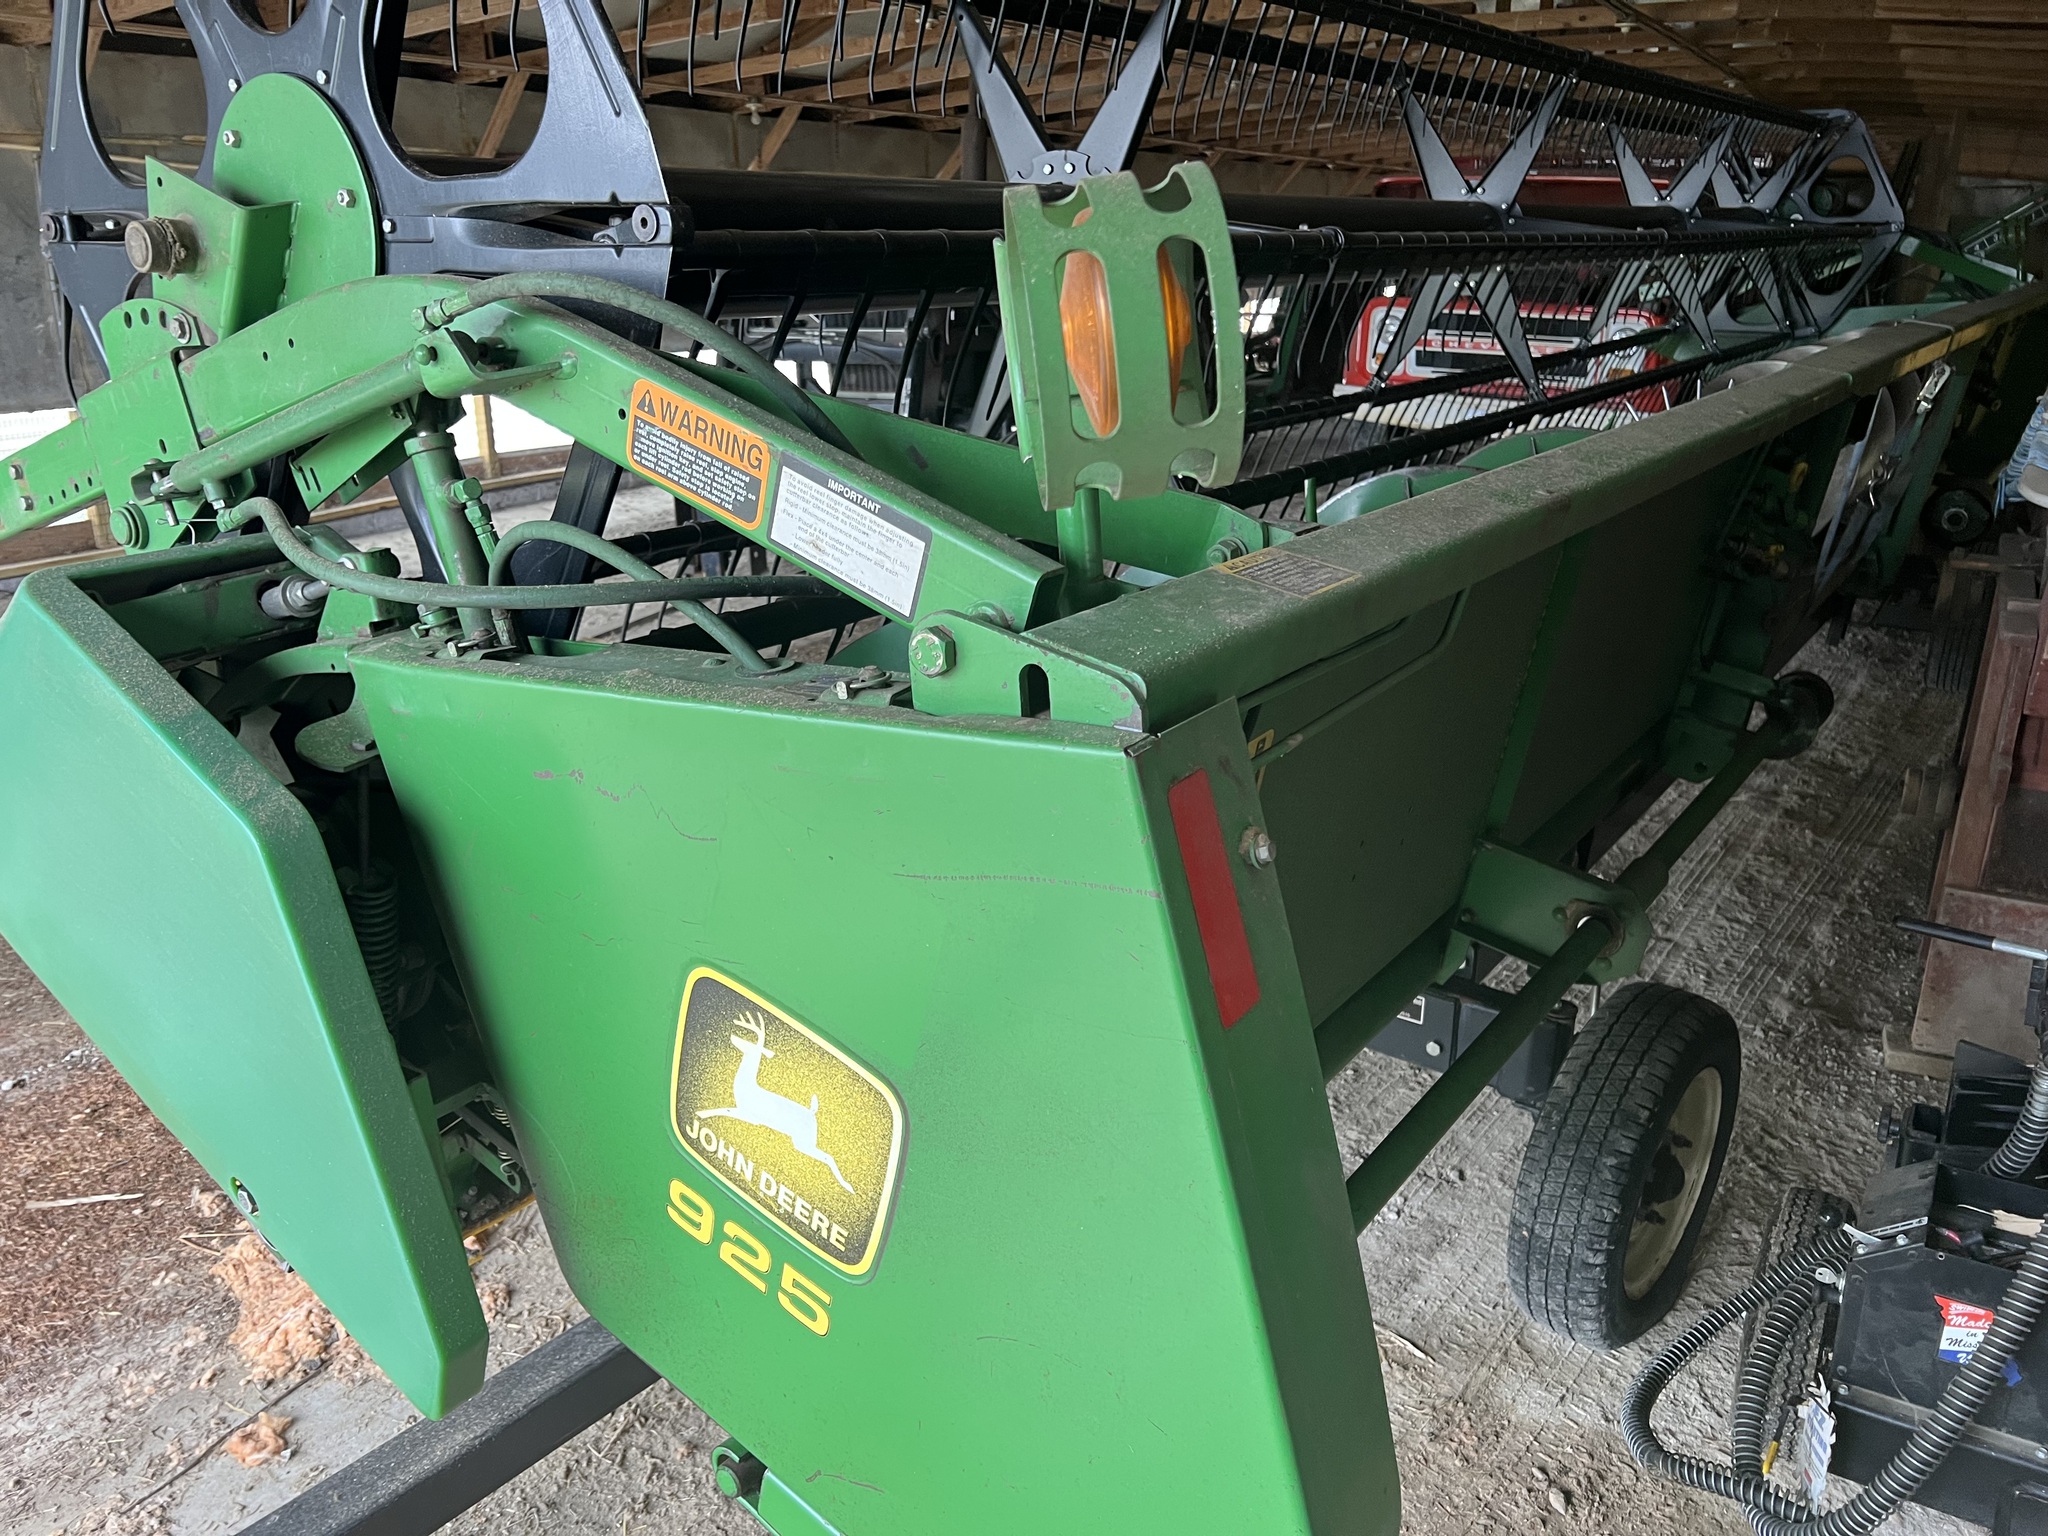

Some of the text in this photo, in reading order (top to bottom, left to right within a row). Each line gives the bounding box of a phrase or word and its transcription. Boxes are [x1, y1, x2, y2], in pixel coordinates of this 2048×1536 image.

[645, 425, 661, 437] aid
[660, 397, 763, 472] WARNING
[827, 479, 881, 514] IMPORTANT
[686, 1120, 849, 1252] JOHN DEERE
[666, 1178, 832, 1338] 925
